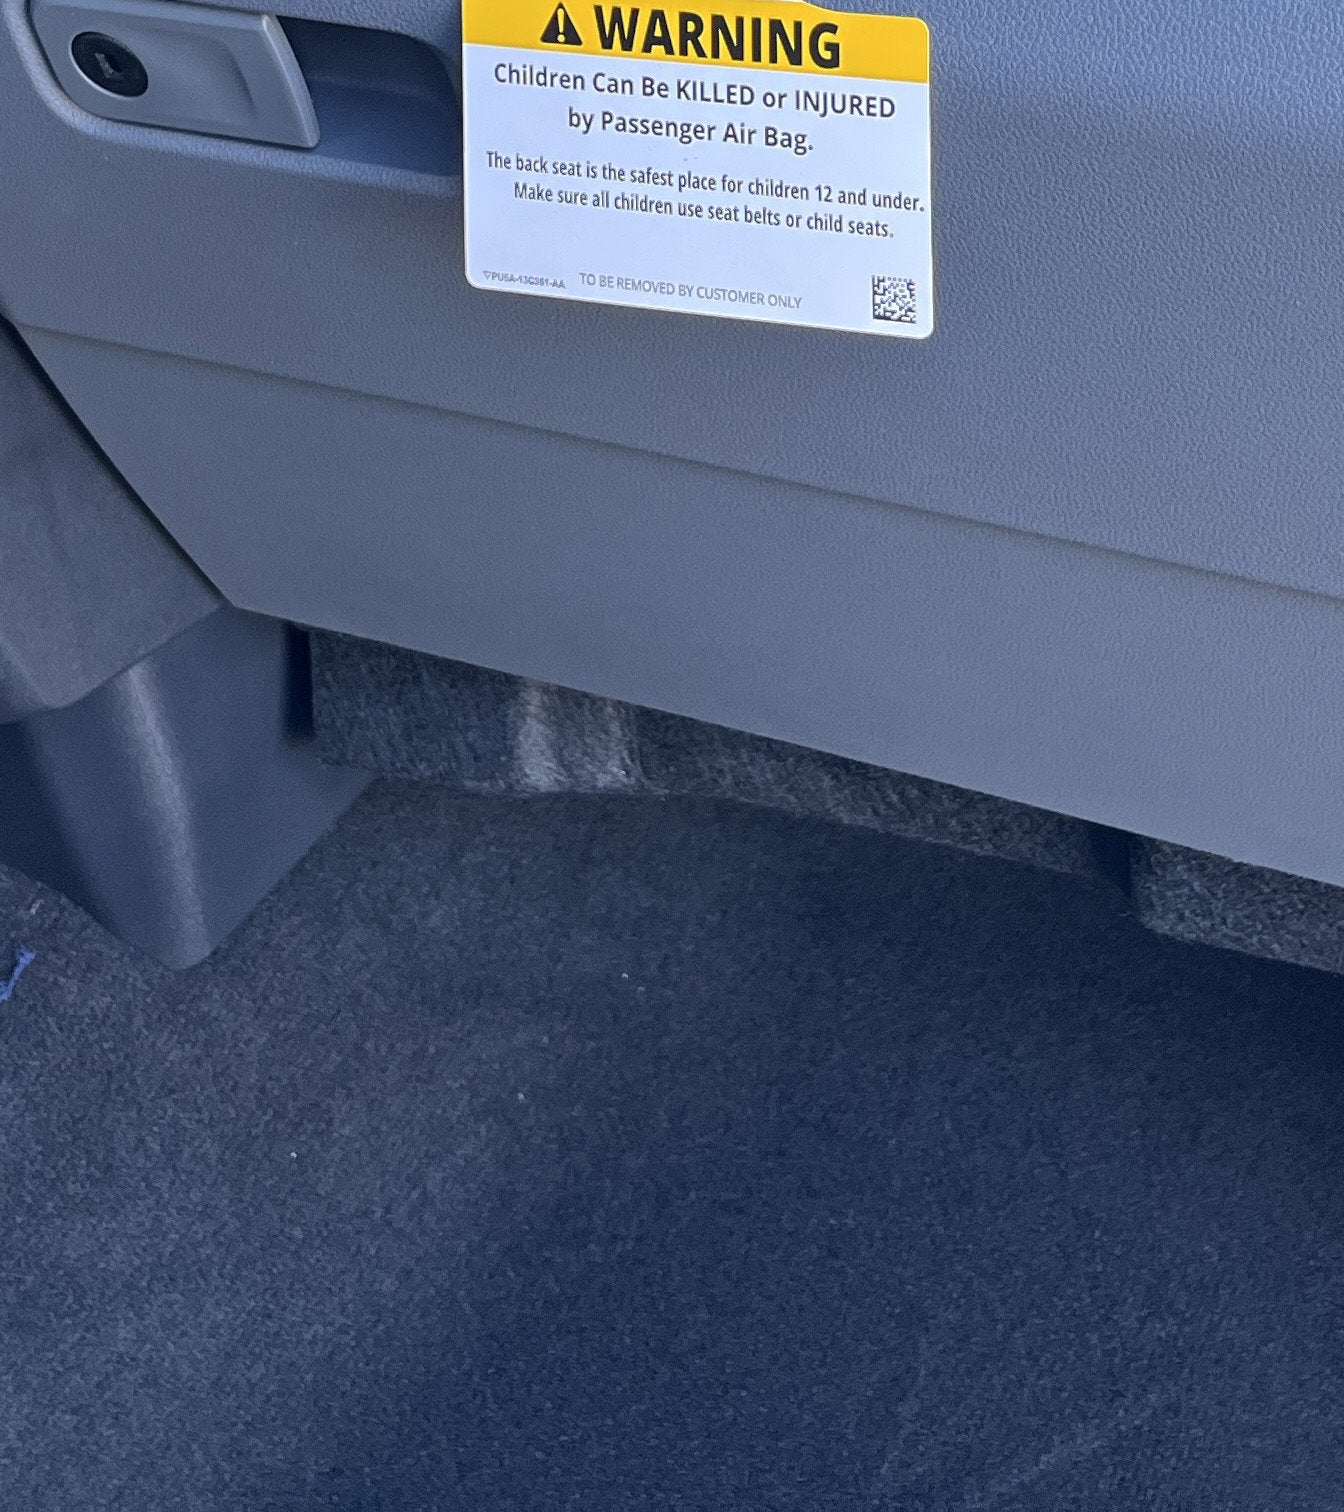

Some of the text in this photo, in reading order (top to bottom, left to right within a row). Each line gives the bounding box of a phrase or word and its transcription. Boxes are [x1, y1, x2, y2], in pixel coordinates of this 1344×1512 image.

[593, 4, 841, 69] WARNING
[494, 62, 896, 119] Children Can Be KILLED or INJURED
[568, 105, 814, 156] by Passenger Air Bag.
[486, 150, 925, 212] The back seat is the safest place for children 12 and under.
[514, 180, 895, 239] Make sure all children use seat belts or child seats.
[579, 272, 803, 310] TO BE REMOVED BY CUSTOMER ONLY
